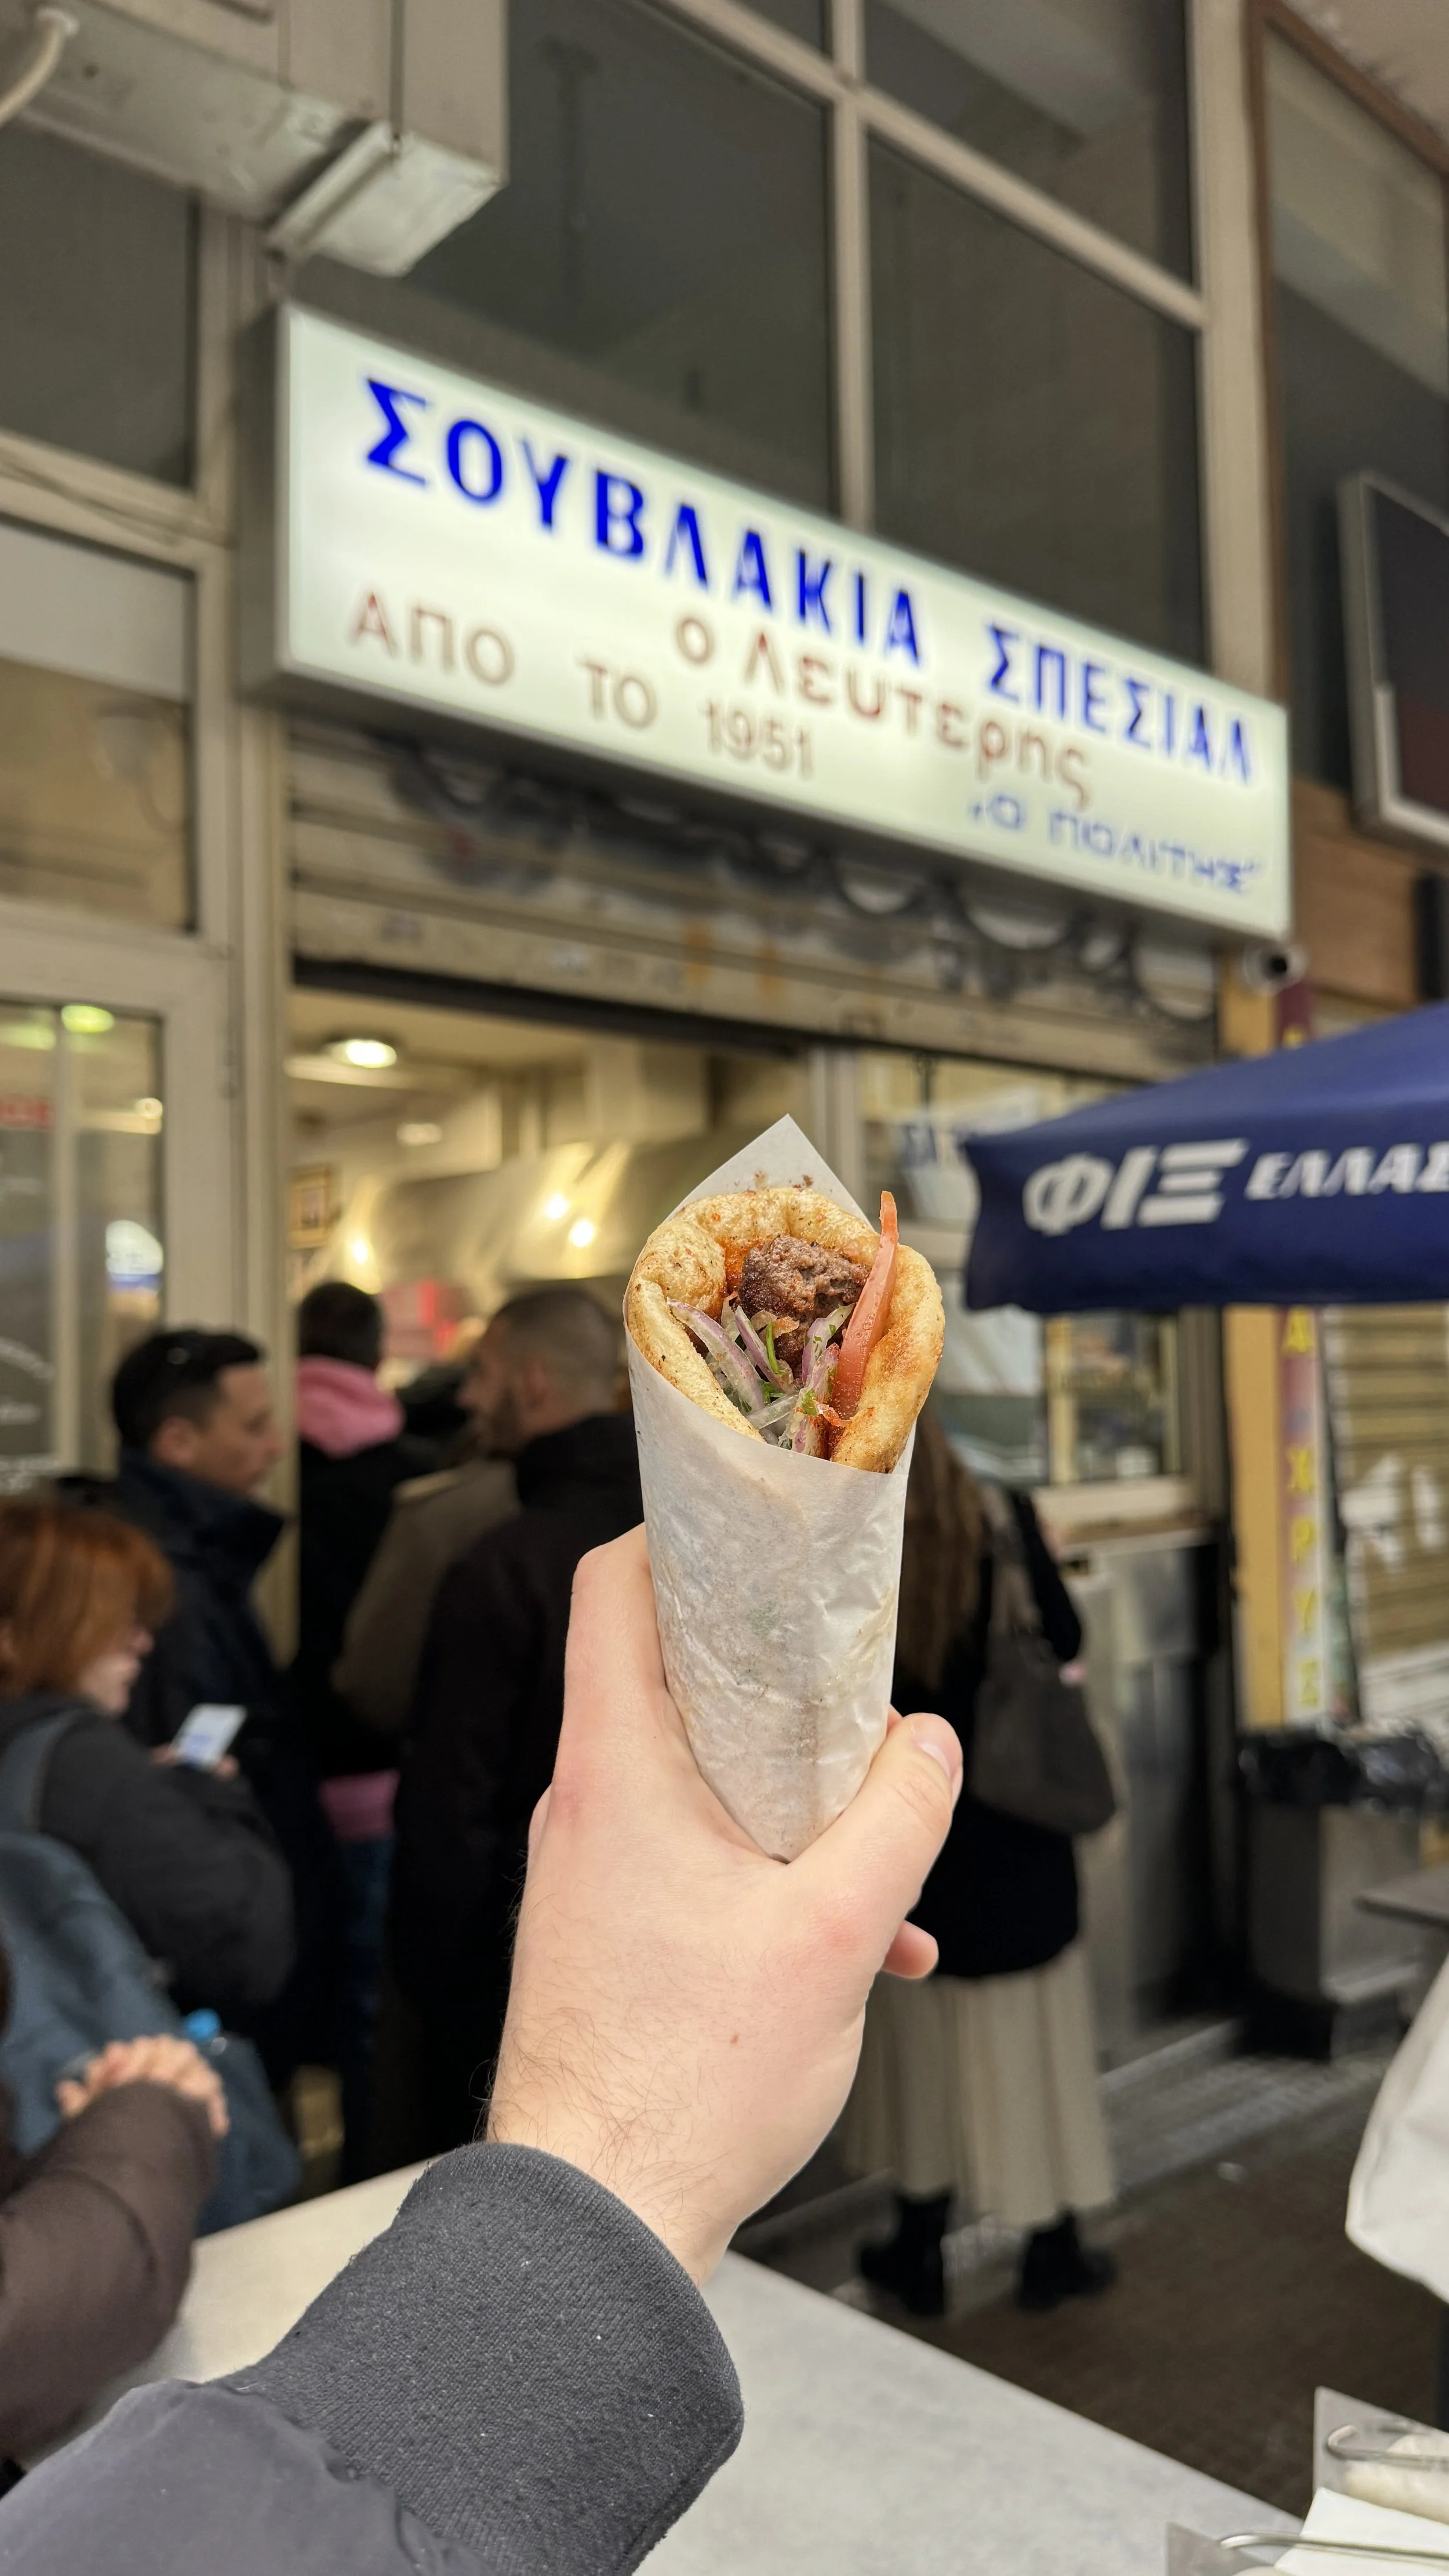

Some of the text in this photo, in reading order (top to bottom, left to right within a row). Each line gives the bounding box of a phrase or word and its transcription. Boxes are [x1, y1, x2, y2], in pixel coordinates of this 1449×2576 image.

[364, 377, 1252, 784] ΣΟΥΒΛΑΚΙΑ ΣΠΕΣΙΑΛ
[349, 591, 811, 780] ΑΠΟ ΤΟ 1951
[1022, 1137, 1248, 1236] ΦΙΞ
